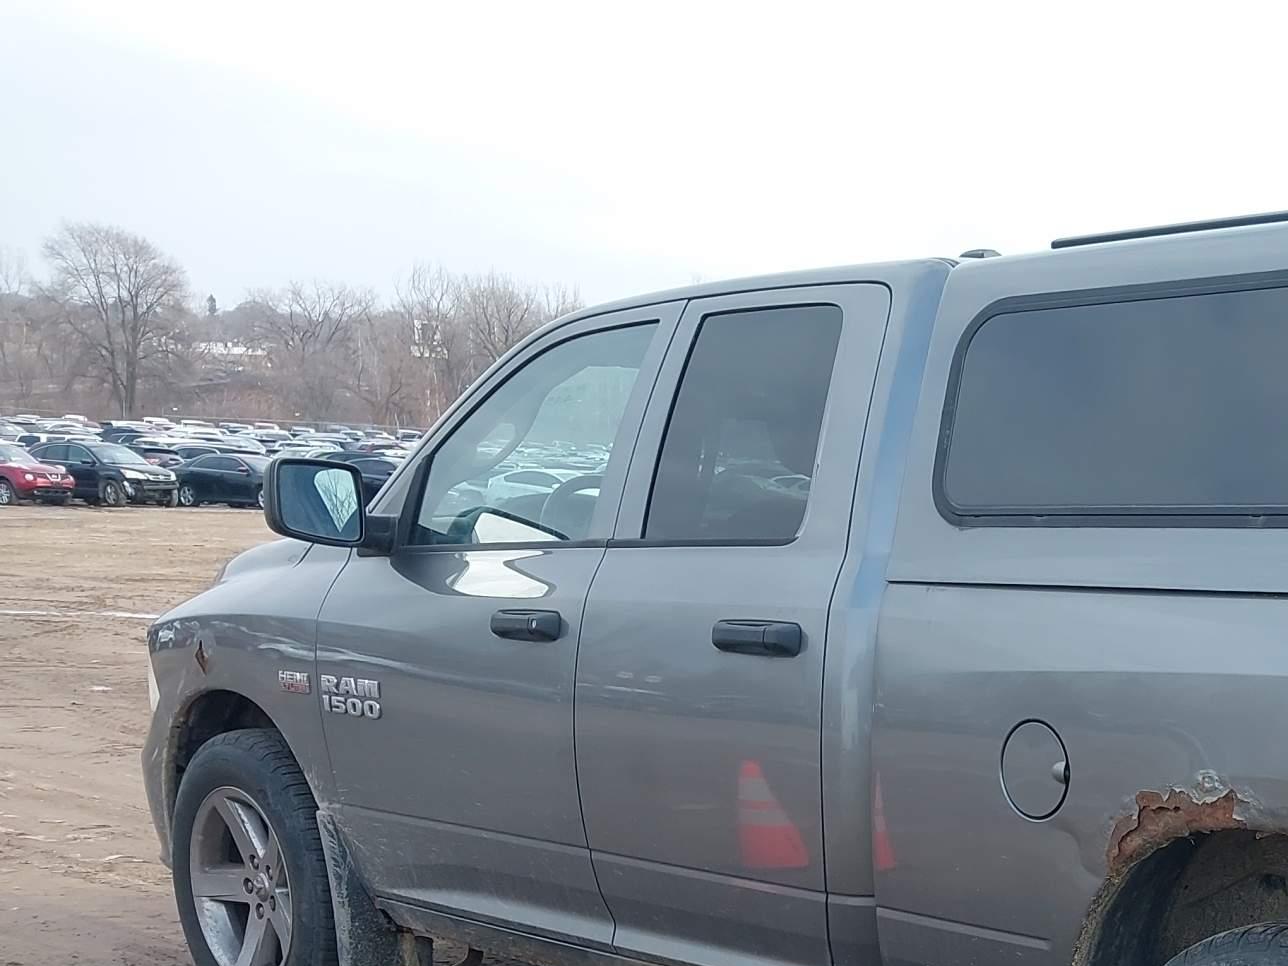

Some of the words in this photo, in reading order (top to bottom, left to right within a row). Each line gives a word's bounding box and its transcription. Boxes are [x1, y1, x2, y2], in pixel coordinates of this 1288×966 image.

[278, 671, 308, 684] HEMI
[320, 674, 381, 698] RAM
[322, 695, 382, 720] 1500
